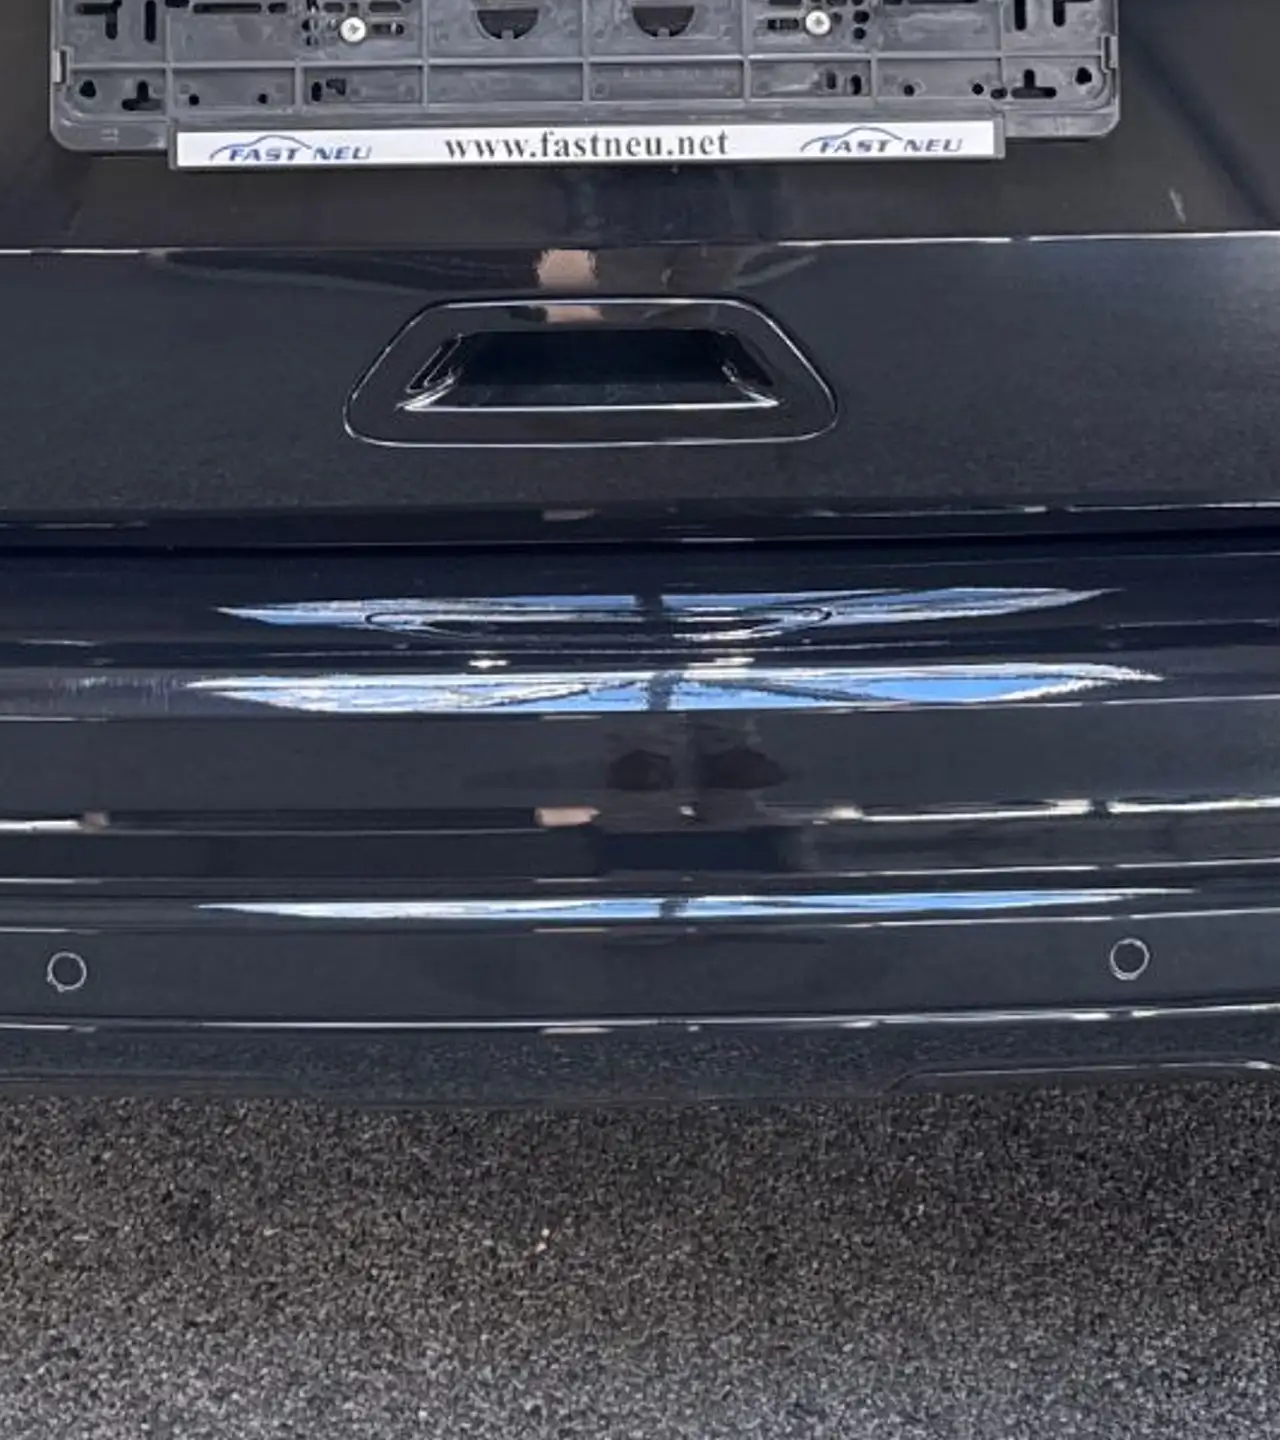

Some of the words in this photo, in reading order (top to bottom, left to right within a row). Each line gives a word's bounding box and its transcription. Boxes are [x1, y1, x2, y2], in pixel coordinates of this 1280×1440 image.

[444, 129, 729, 159] www.fastneu.net
[819, 138, 893, 154] FAST
[903, 137, 964, 153] NEU
[228, 146, 303, 162] FAST
[312, 145, 372, 161] NEU
